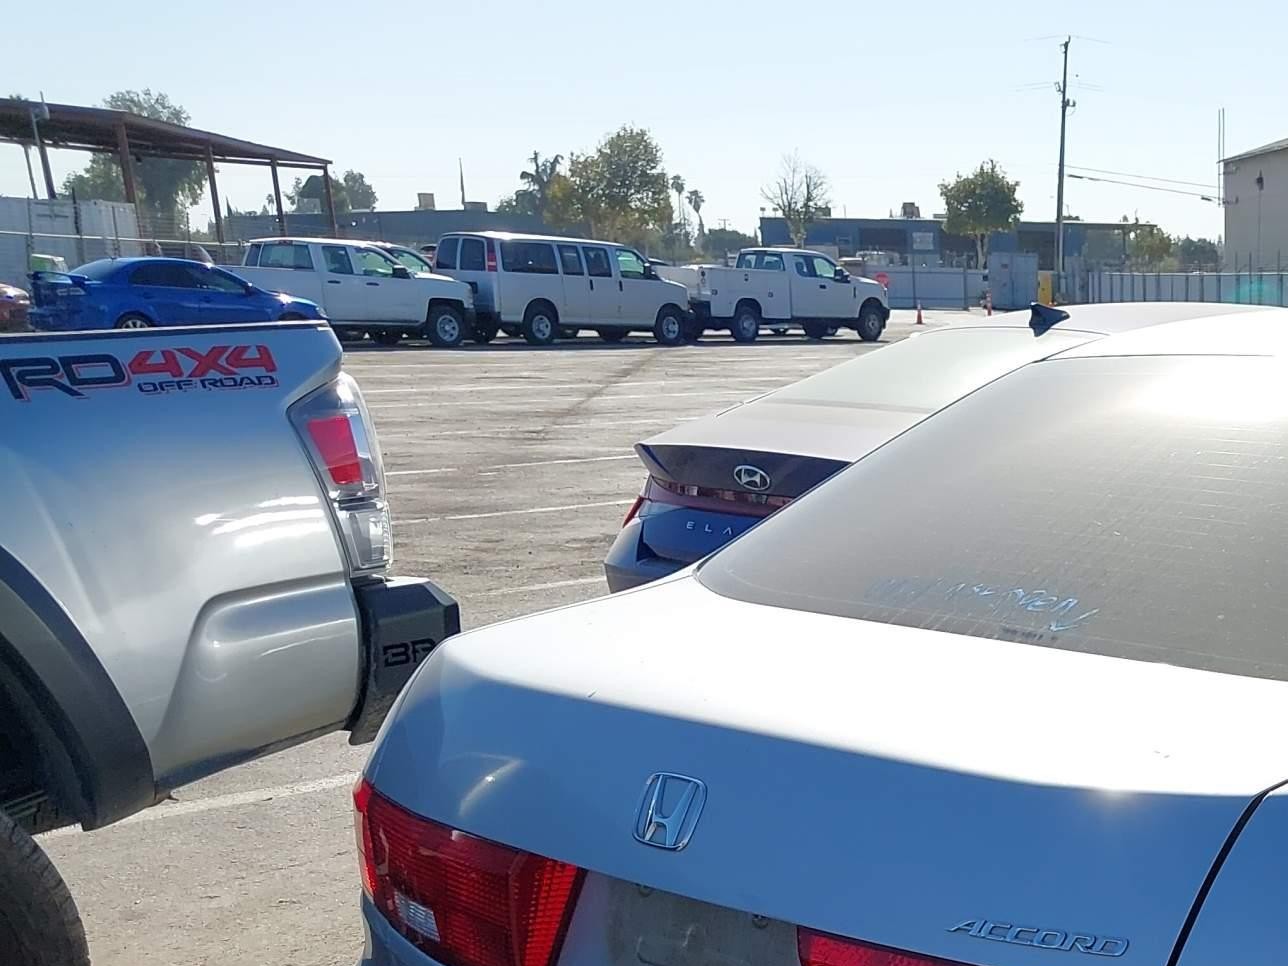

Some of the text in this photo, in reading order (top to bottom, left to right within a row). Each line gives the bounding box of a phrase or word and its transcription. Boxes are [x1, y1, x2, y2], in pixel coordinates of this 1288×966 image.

[138, 375, 279, 395] OFF ROAD
[946, 919, 1129, 957] ACCORD
